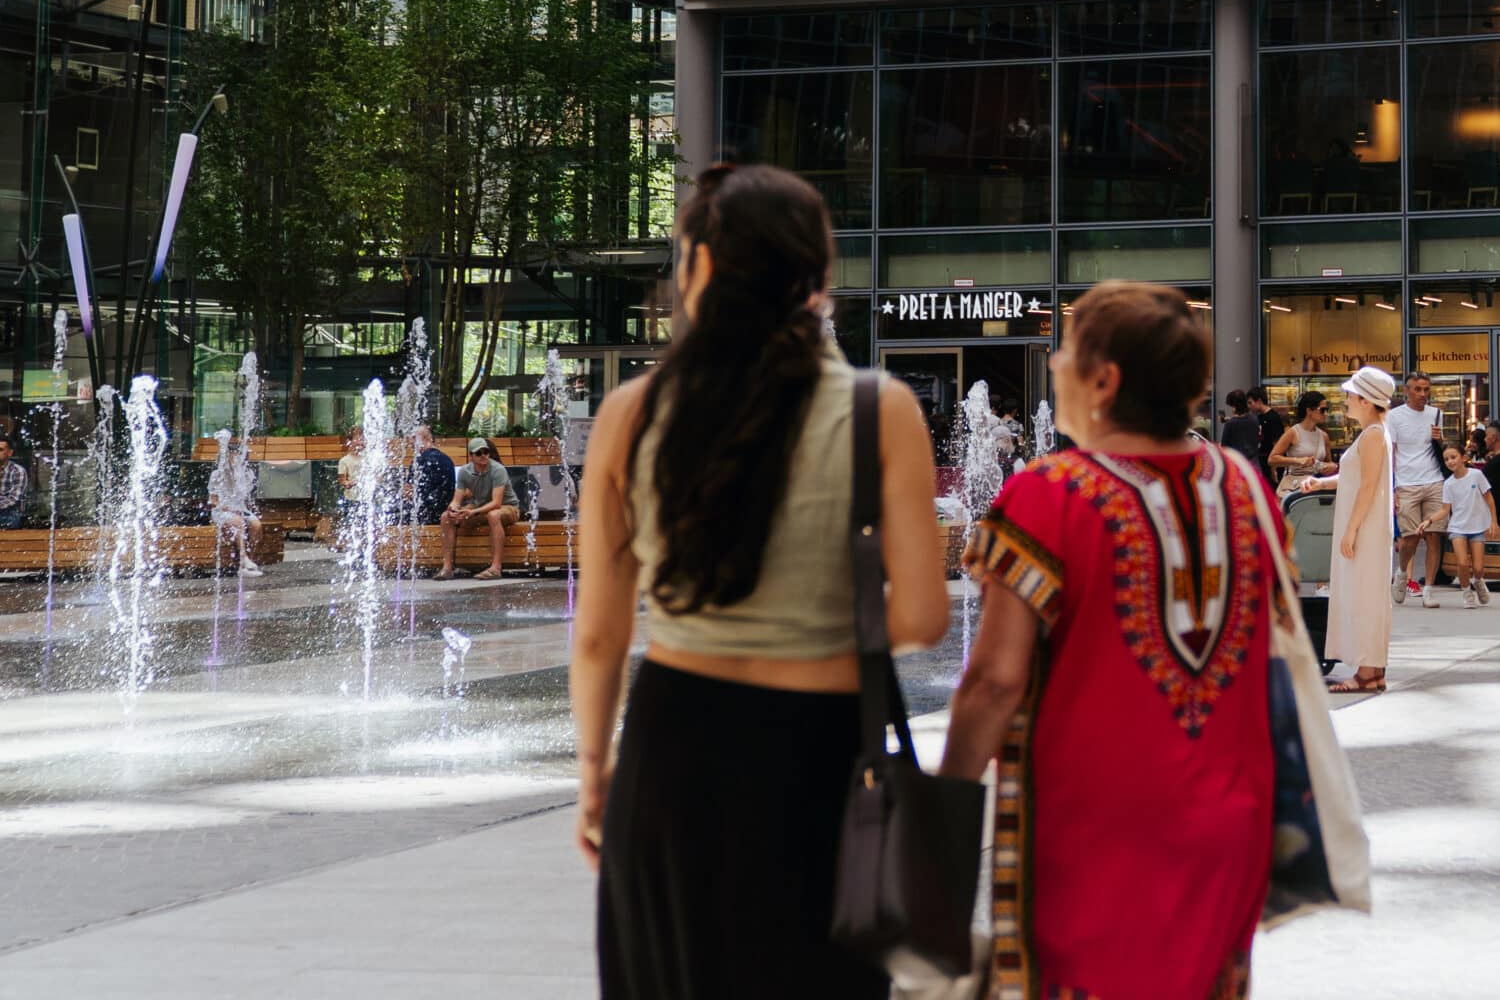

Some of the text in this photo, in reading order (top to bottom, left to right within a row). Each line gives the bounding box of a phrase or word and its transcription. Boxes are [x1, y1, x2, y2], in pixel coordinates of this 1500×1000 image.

[900, 292, 1023, 320] PRET A MANGER
[1432, 351, 1471, 361] kitchen
